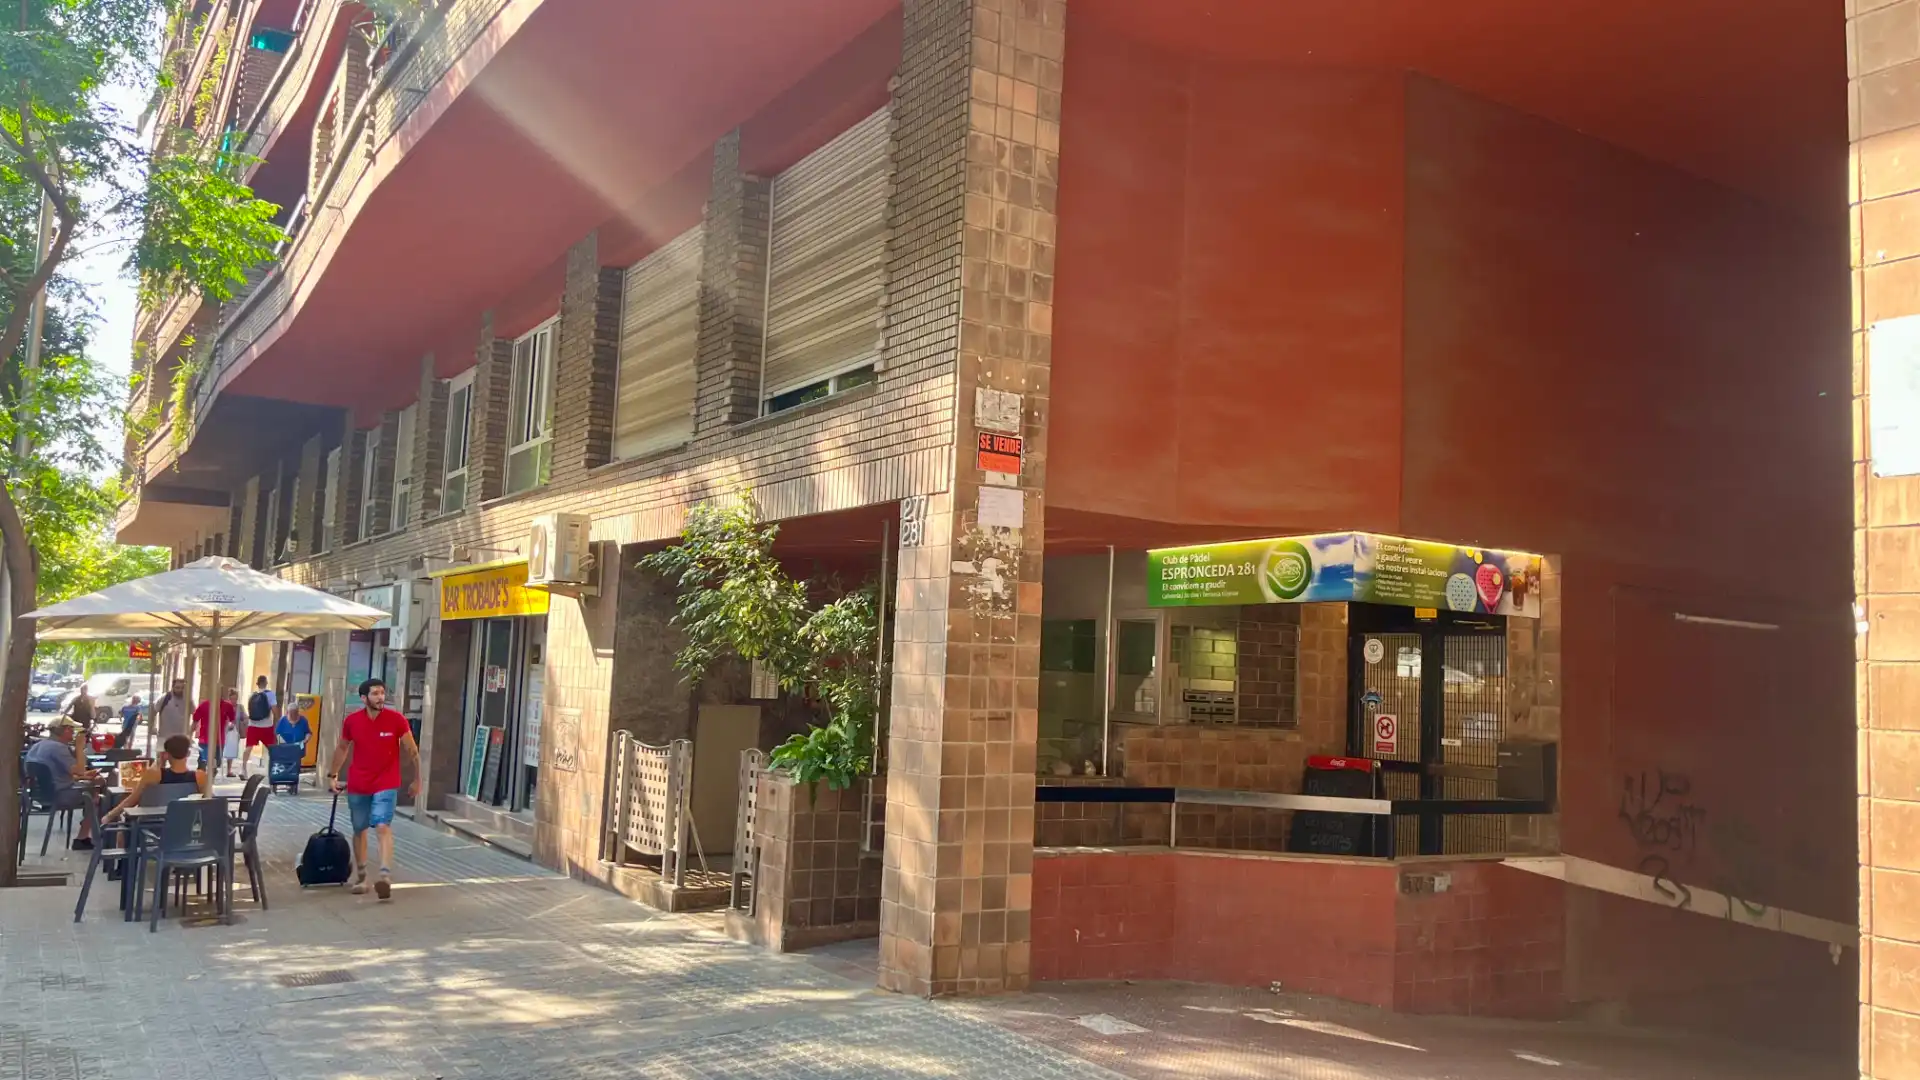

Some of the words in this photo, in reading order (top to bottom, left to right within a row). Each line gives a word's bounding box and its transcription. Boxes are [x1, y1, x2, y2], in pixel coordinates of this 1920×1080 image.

[980, 434, 991, 449] SE
[993, 436, 1020, 454] VENDE
[903, 496, 928, 520] 277
[902, 519, 925, 546] 281
[1384, 544, 1415, 553] convidem
[1162, 555, 1178, 565] Club
[1179, 555, 1189, 564] de
[1190, 552, 1210, 563] Pàdel
[1161, 563, 1235, 580] ESPRONCEDA
[1237, 562, 1256, 576] 281
[1386, 564, 1409, 573] nostres
[443, 585, 460, 612] BAR
[462, 576, 509, 611] TROBADE'S
[1162, 583, 1168, 591] Et
[1169, 582, 1200, 591] convidem
[1205, 580, 1226, 591] gaudir
